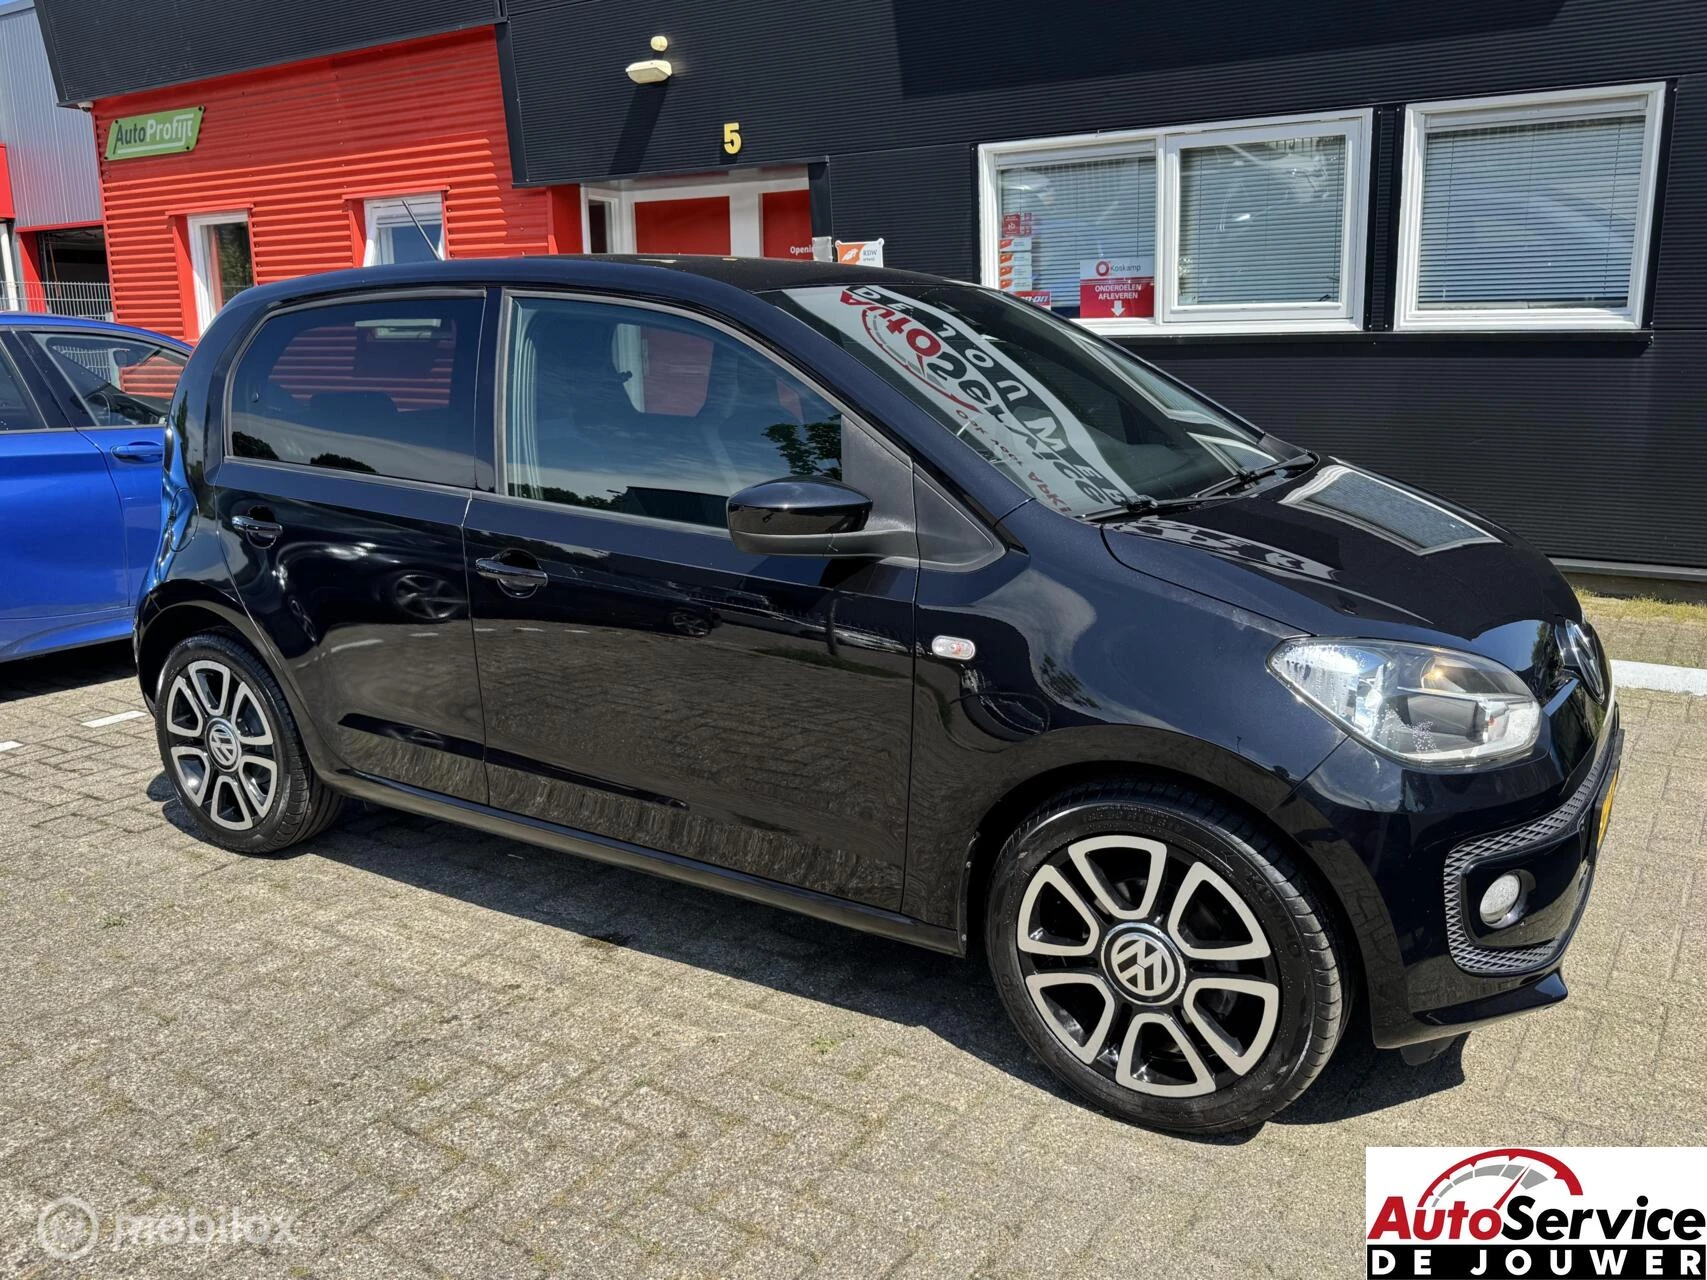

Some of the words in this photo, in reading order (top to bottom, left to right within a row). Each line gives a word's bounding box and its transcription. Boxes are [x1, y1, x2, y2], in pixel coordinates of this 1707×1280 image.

[723, 122, 742, 155] 5
[1110, 264, 1142, 273] Koskamp
[1094, 284, 1142, 293] ONDERDELEN
[1098, 291, 1139, 300] AFLEVEREN
